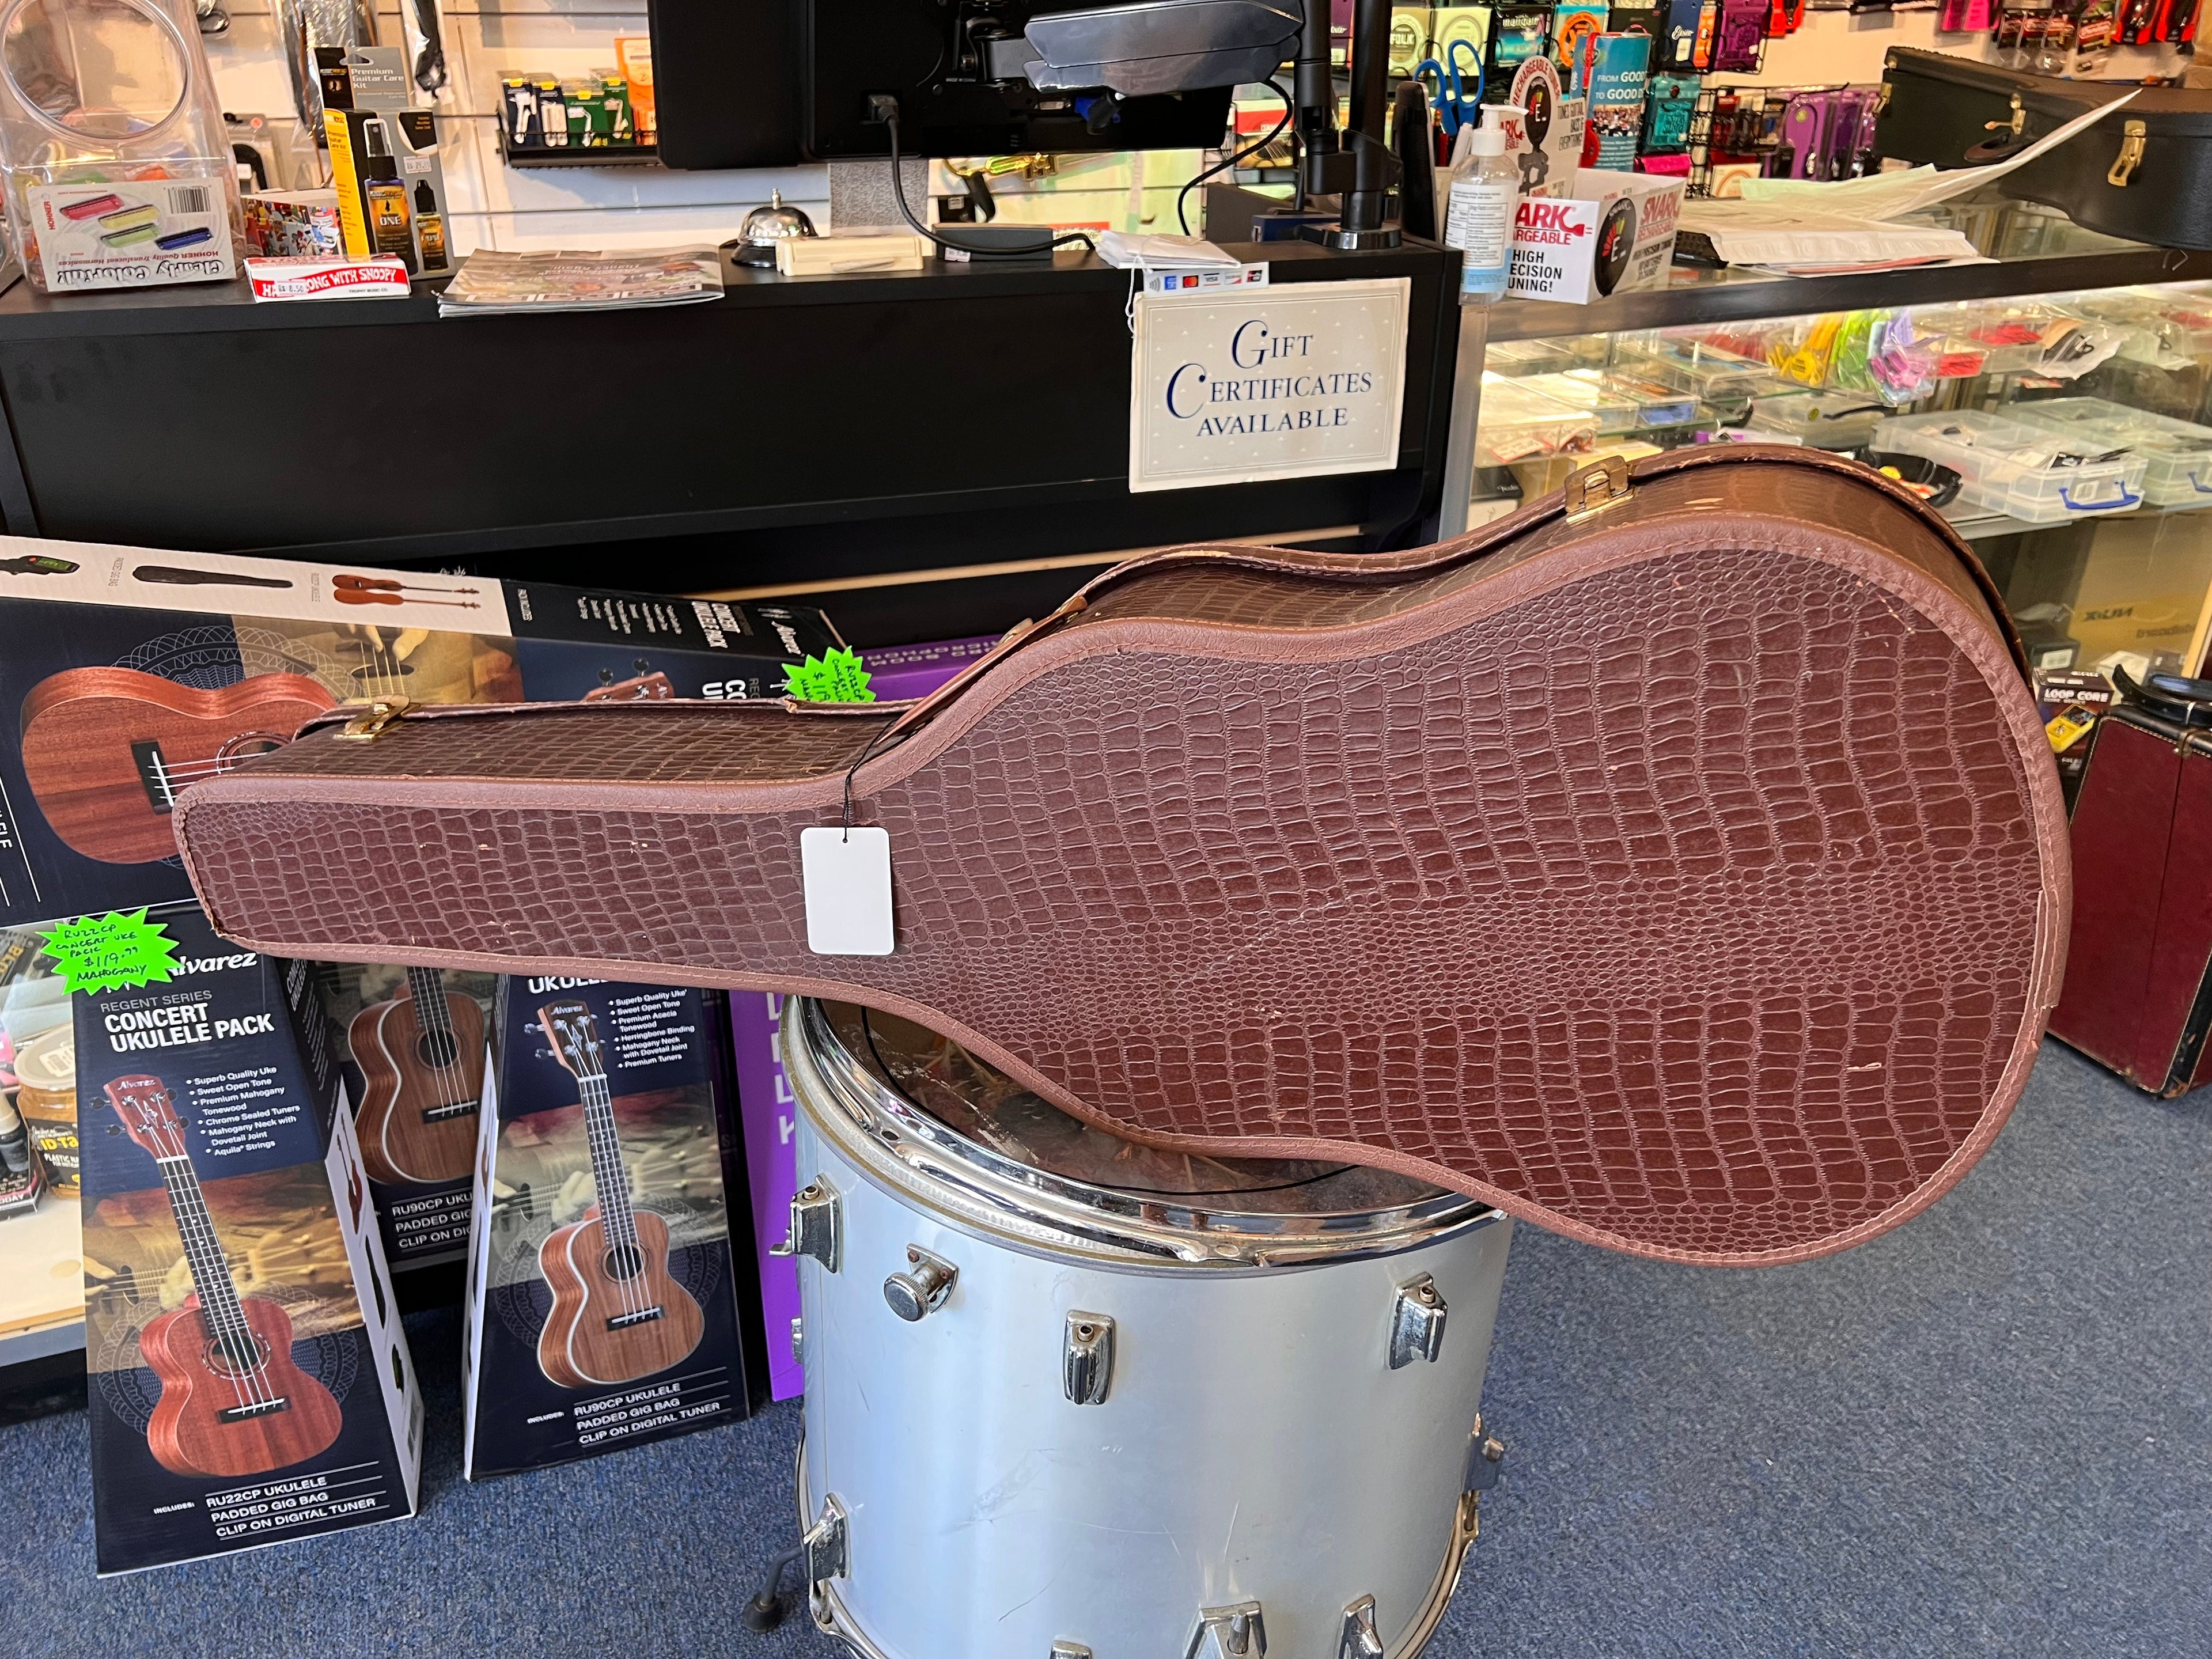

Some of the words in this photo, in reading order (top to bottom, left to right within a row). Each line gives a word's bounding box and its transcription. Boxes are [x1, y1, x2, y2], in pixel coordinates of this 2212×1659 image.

[1597, 74, 1619, 83] FROM
[43, 201, 56, 230] HOHNER
[379, 215, 402, 226] ONE
[1515, 202, 1577, 233] ARK
[1514, 229, 1572, 245] RGEABLE
[58, 258, 104, 267] Harmonicas
[105, 255, 150, 263] Translucent
[152, 253, 179, 262] Quality
[181, 250, 219, 259] HOHNER
[1513, 249, 1544, 264] HIGH
[156, 259, 225, 278] Clearly
[329, 270, 358, 287] WITH
[359, 267, 397, 282] SNOOPY
[1510, 263, 1562, 279] ECISION
[1508, 277, 1553, 293] UNING!
[1231, 320, 1315, 369] GIFT
[1166, 362, 1373, 419] CERTIFICATES
[1196, 407, 1349, 437] AVAILABLE
[2044, 688, 2074, 699] LOOP
[2077, 691, 2108, 703] CORE
[55, 936, 109, 950] CONCERT
[84, 946, 138, 968] $119.99
[76, 964, 147, 982] MAHOGANY
[100, 997, 158, 1013] REGENT
[162, 989, 213, 1006] SERIES
[615, 995, 642, 1006] Superb
[643, 992, 670, 1002] Quality
[616, 1006, 640, 1016] Sweet
[641, 1003, 662, 1012] Open
[662, 1000, 681, 1009] Tone
[104, 1002, 209, 1033] CONCERT
[618, 1014, 652, 1025] Premium
[619, 1020, 657, 1033] Tonewood
[109, 1022, 213, 1053] UKULELE
[214, 1013, 275, 1040] PACK
[621, 1029, 666, 1043] Herringbone
[666, 1025, 695, 1035] Binding
[622, 1039, 660, 1051] Mahogany
[661, 1036, 681, 1045] Neck
[623, 1050, 639, 1059] with
[640, 1045, 670, 1057] Dovetail
[671, 1043, 688, 1052] Joint
[624, 1057, 657, 1069] Premium
[657, 1054, 683, 1063] Tuners
[117, 1078, 156, 1091] Alvarez
[194, 1074, 226, 1086] Superb
[227, 1070, 258, 1081] Quality
[259, 1066, 278, 1075] Uke
[197, 1085, 224, 1096] Sweet
[225, 1081, 250, 1092] Open
[250, 1078, 272, 1088] Tone
[200, 1094, 239, 1106] Premium
[240, 1086, 285, 1100] Mahogany
[202, 1102, 247, 1116] Tonewood
[206, 1115, 240, 1127] Chrome
[241, 1109, 271, 1121] Sealed
[271, 1104, 301, 1116] Tuners
[209, 1123, 253, 1137] Mahogany
[255, 1119, 278, 1129] Neck
[278, 1115, 297, 1125] with
[40, 1137, 58, 1151] ID
[211, 1134, 247, 1146] Dovetail
[248, 1131, 268, 1141] Joint
[245, 1140, 276, 1152] Strings
[392, 1198, 443, 1217] RU90CP
[395, 1213, 448, 1233] PADDED
[398, 1234, 427, 1249] CLIP
[430, 1229, 450, 1242] ON
[574, 1397, 623, 1416] RU90CP
[625, 1382, 681, 1404] UKULELE
[576, 1411, 627, 1431] PADDED
[628, 1404, 653, 1419] GIG
[654, 1397, 681, 1412] BAG
[579, 1430, 607, 1445] CLIP
[609, 1425, 629, 1438] ON
[630, 1414, 679, 1434] DIGITAL
[679, 1402, 721, 1419] TUNER
[205, 1488, 262, 1509] RU22CP
[263, 1475, 328, 1498] UKULELE
[210, 1502, 268, 1524] PADDED
[270, 1498, 297, 1512] GIG
[299, 1491, 329, 1506] BAG
[215, 1522, 247, 1539] CLIP
[249, 1518, 272, 1532] ON
[274, 1508, 327, 1526] DIGITAL
[328, 1498, 376, 1516] TUNER
